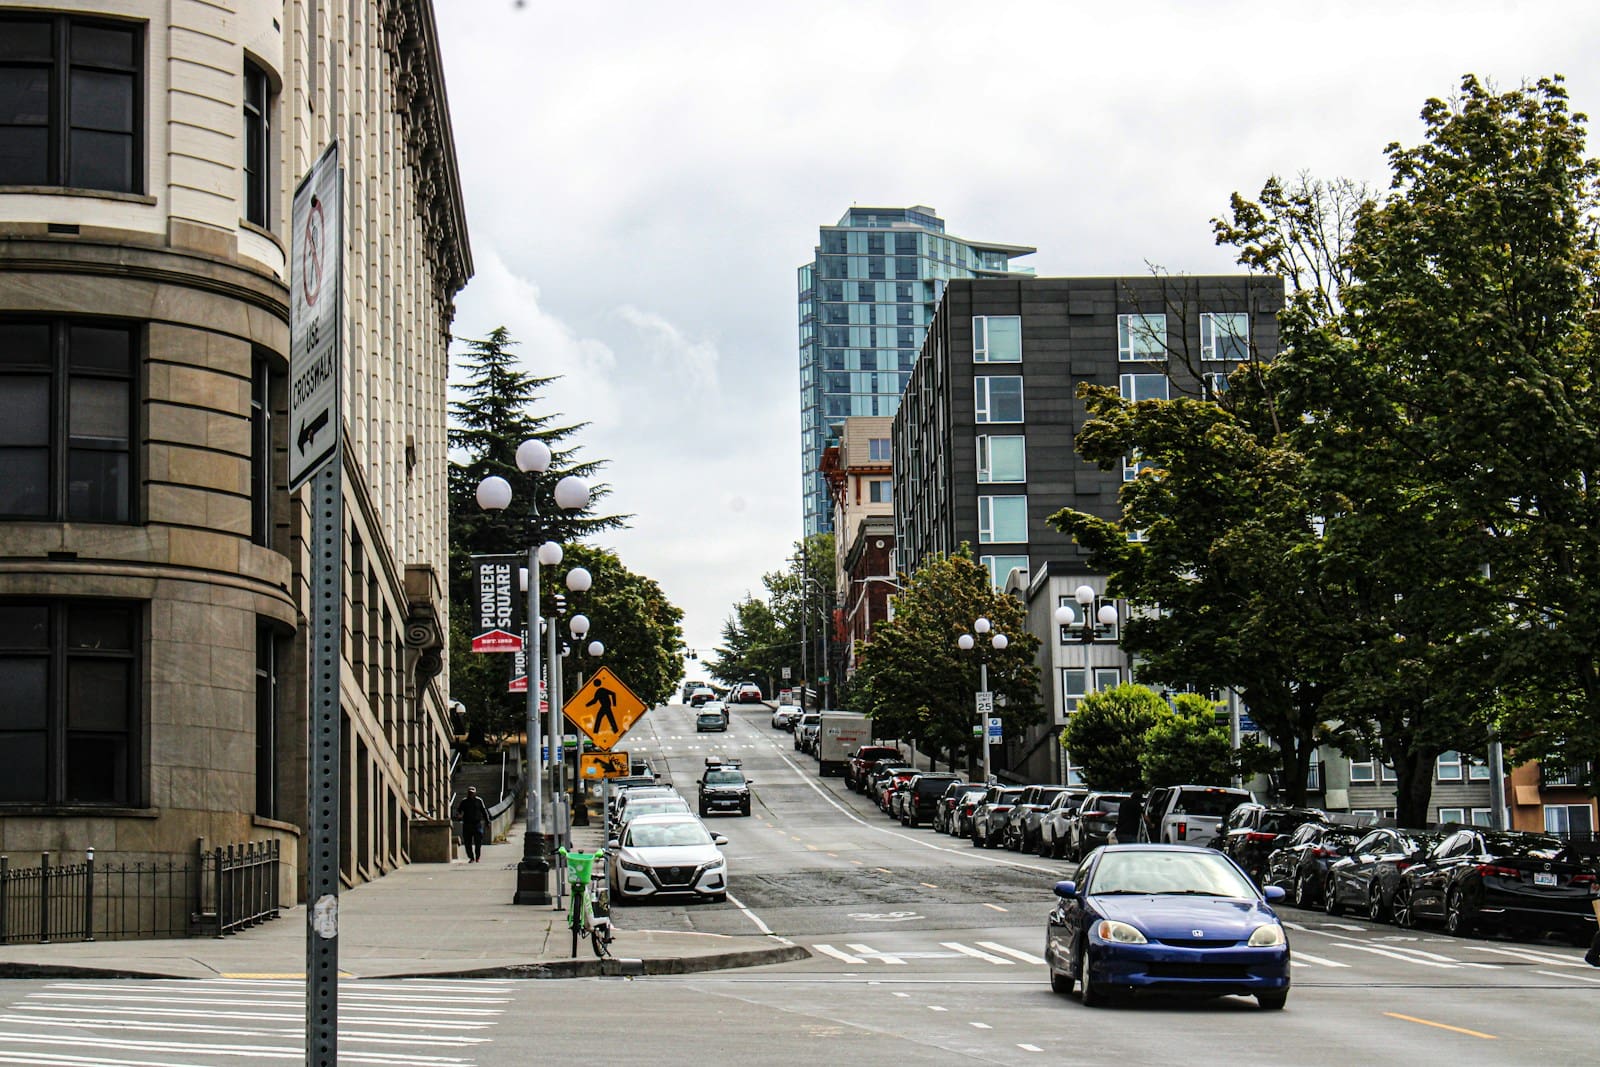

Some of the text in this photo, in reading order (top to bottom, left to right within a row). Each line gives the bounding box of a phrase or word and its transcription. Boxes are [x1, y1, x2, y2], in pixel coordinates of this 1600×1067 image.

[306, 316, 320, 354] USE
[293, 345, 333, 411] CROSSWALK
[480, 564, 496, 628] PIONEER
[496, 563, 512, 628] SQUARE
[978, 703, 992, 711] 25
